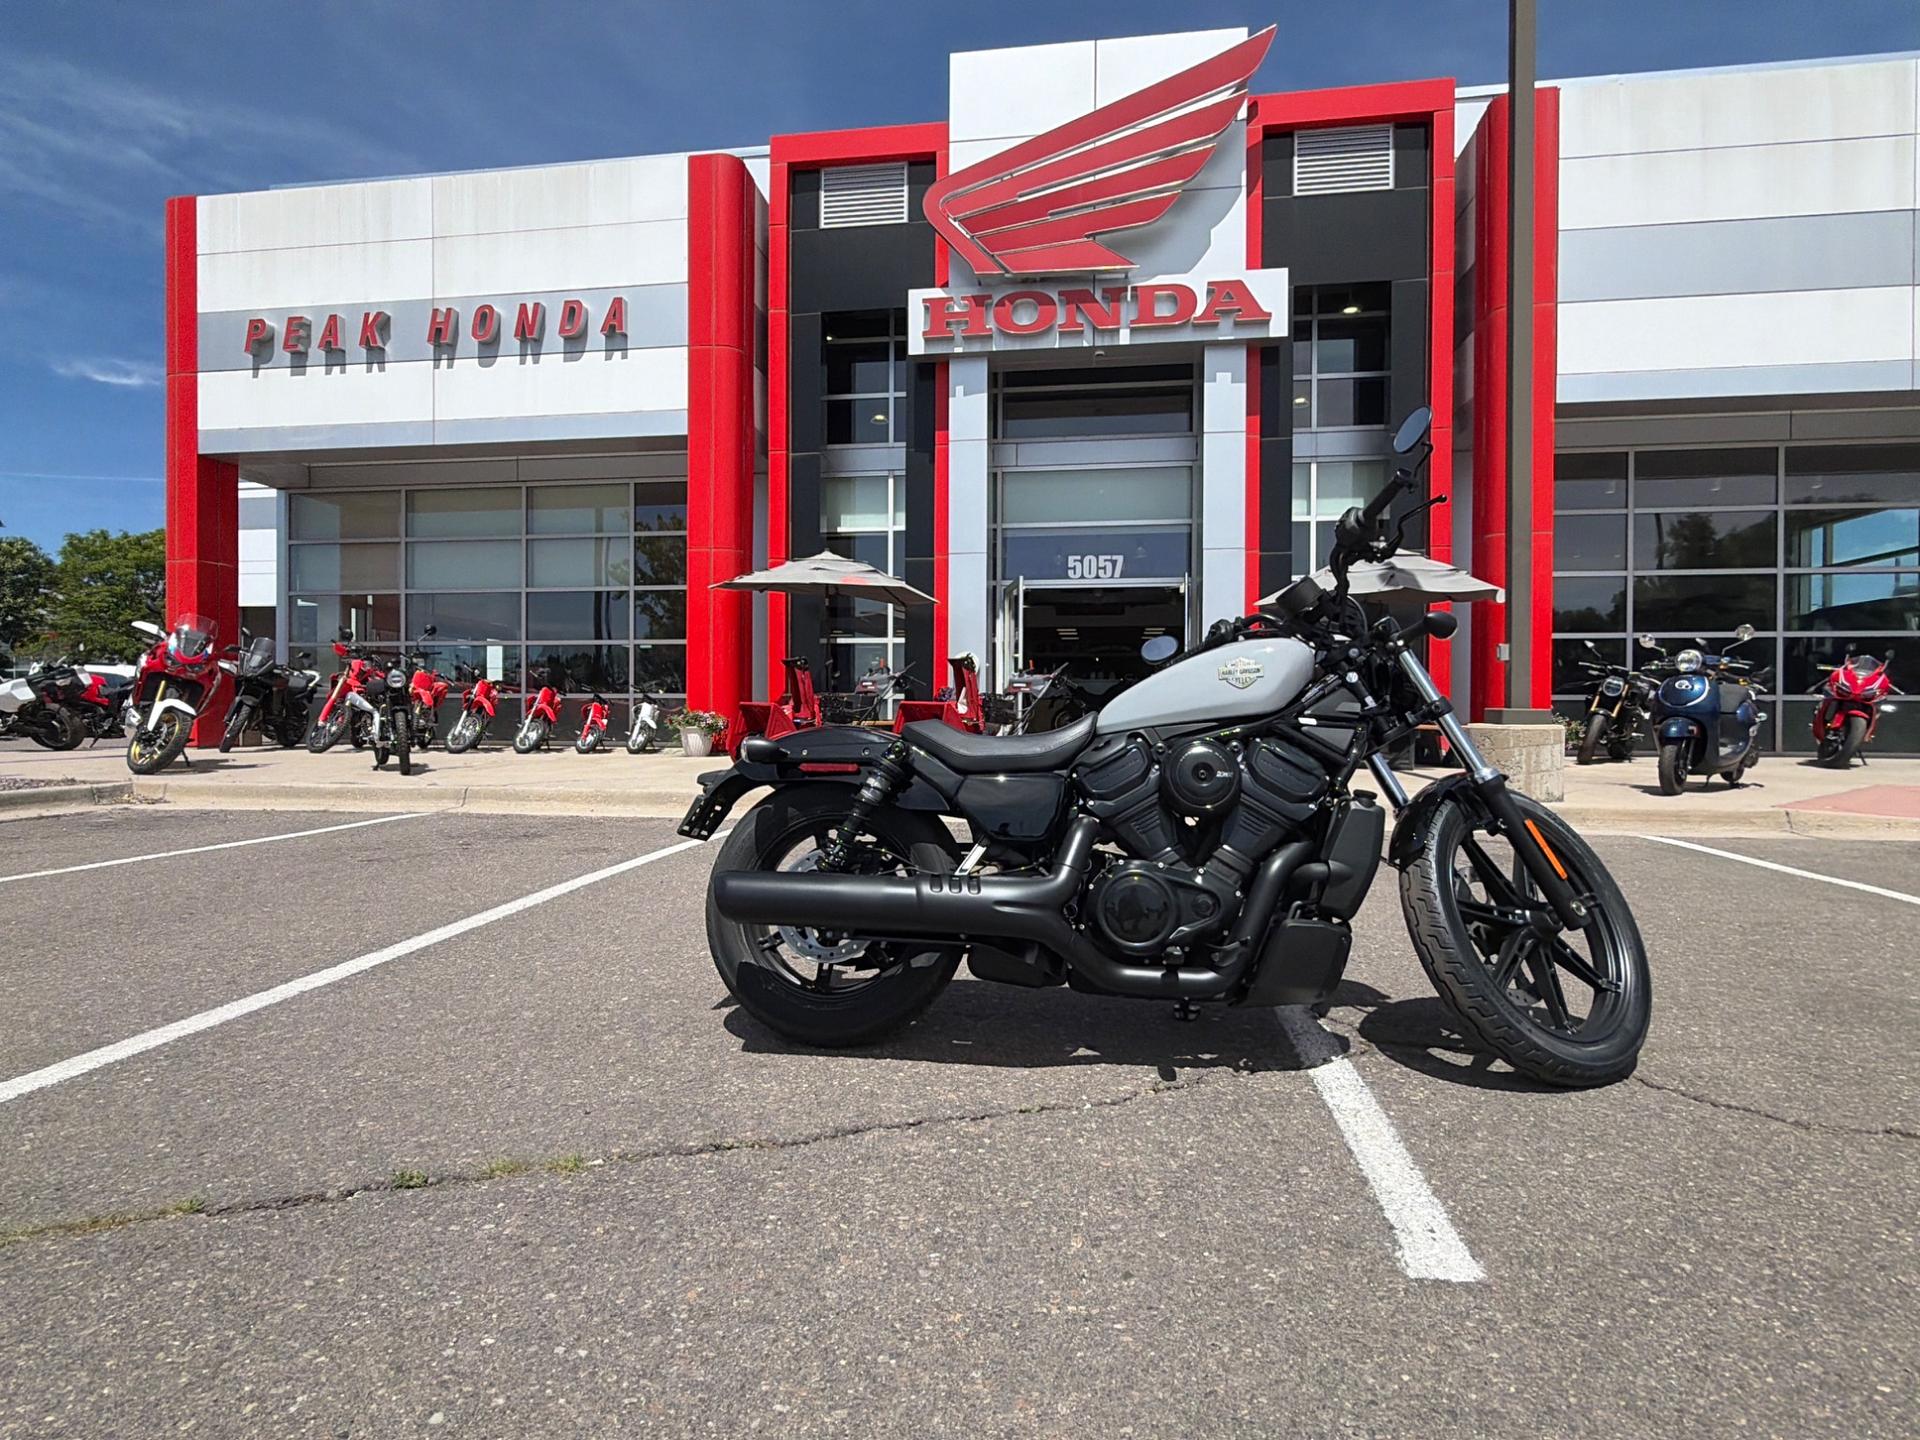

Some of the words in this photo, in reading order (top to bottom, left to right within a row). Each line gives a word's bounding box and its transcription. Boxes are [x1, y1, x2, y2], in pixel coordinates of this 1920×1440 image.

[243, 310, 392, 355] PEAK
[427, 296, 628, 346] HONDA
[922, 279, 1272, 337] HONDA
[1067, 554, 1124, 579] 5057
